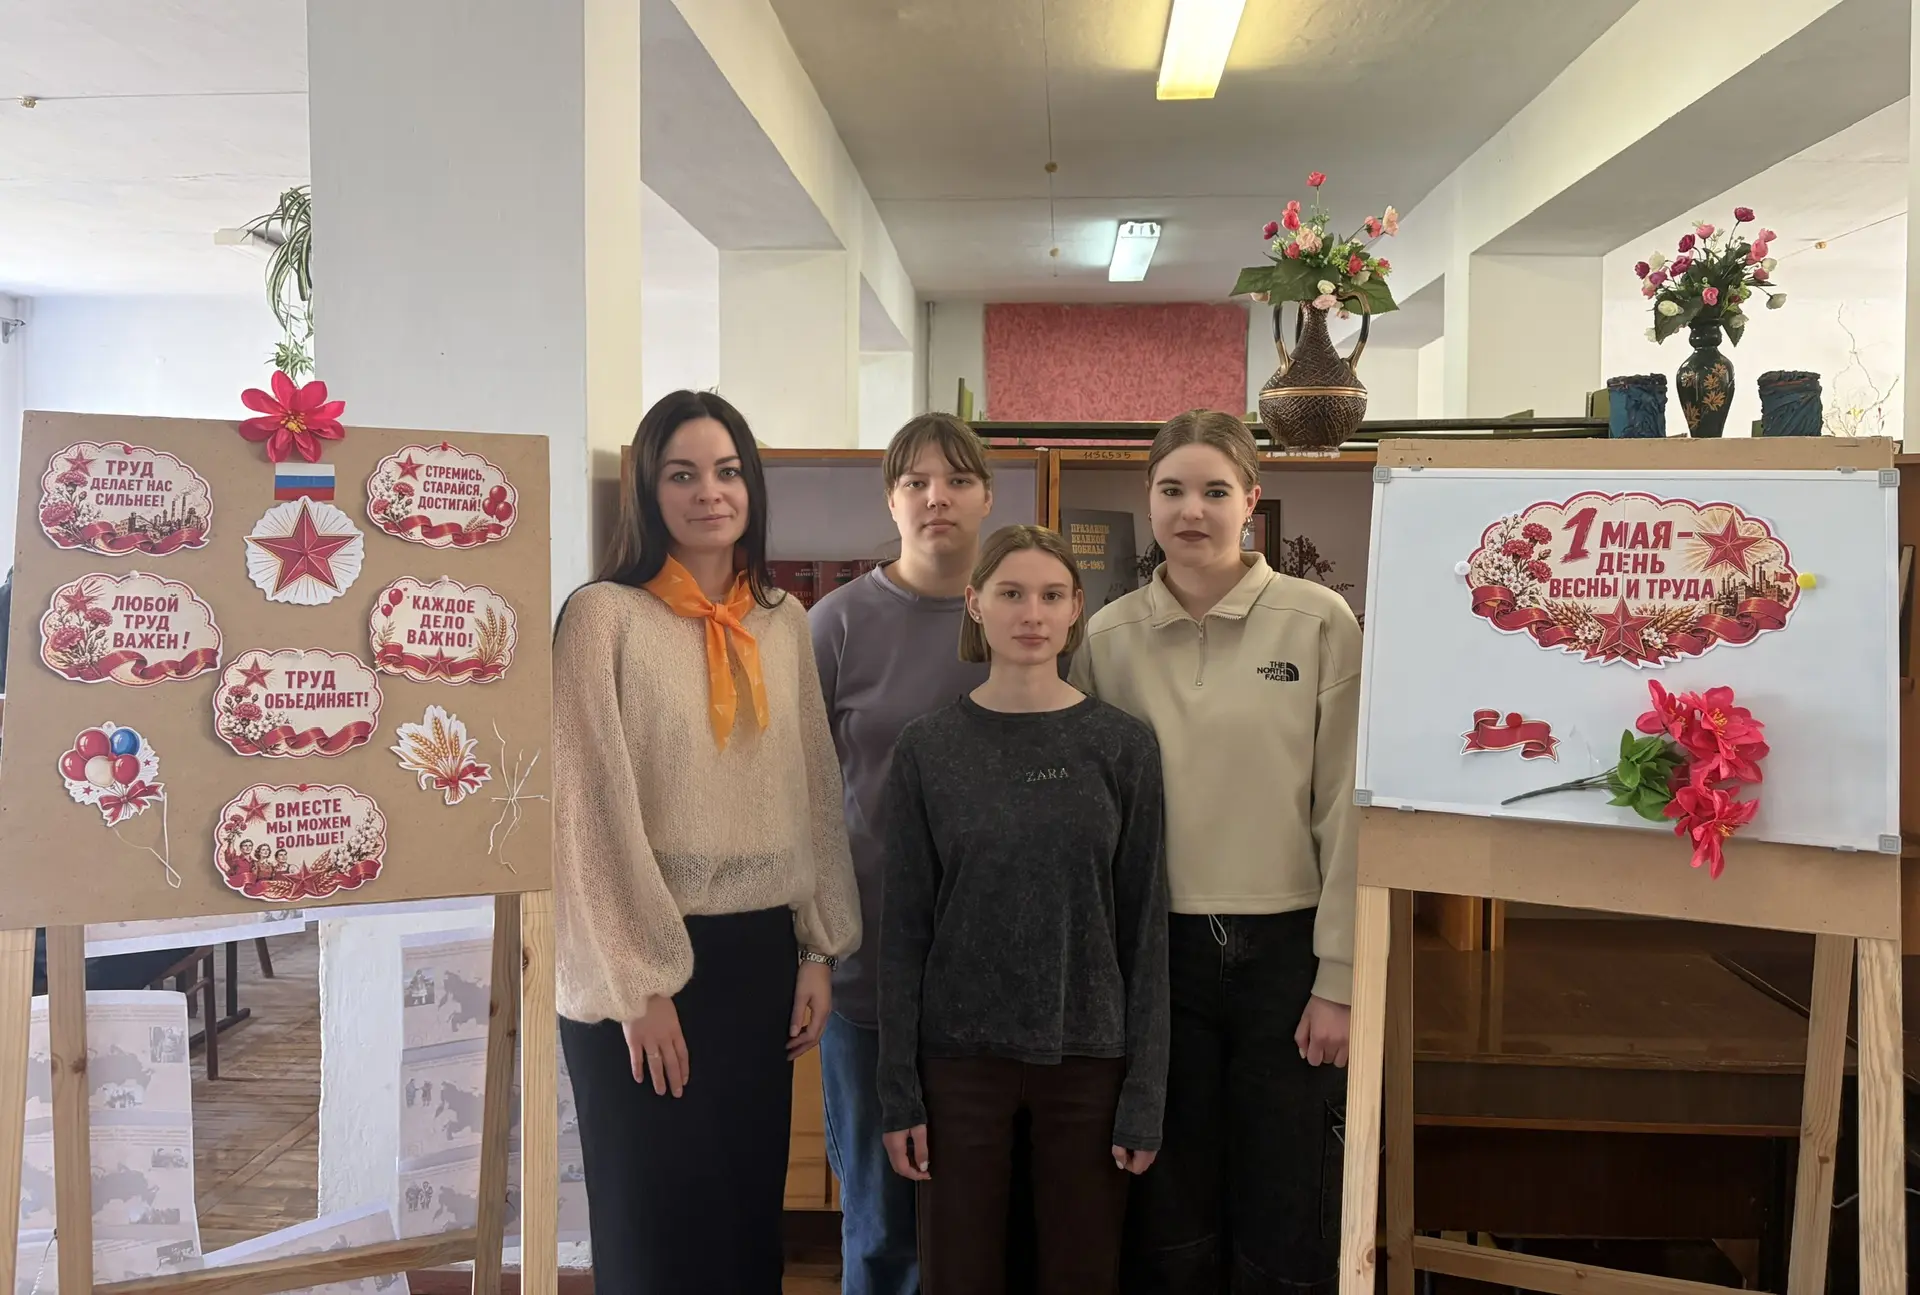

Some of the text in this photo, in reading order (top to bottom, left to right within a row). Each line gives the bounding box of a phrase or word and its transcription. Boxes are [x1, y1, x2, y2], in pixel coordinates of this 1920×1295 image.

[105, 460, 154, 479] ТРУД
[425, 465, 485, 483] СТРЕМИСЬ,
[90, 477, 173, 492] ДЕЛАЕТ НАС
[423, 480, 483, 498] СТАРАЙСЯ,
[95, 493, 165, 508] СИЛЬНЕЕ!
[417, 495, 481, 512] ДОСТИГАЙ!
[1559, 507, 1598, 564] 1
[1595, 551, 1666, 576] ДЕНЬ
[1549, 577, 1715, 602] ВЕСНЫ И ТРУДА
[111, 593, 179, 612] ЛЮБОЙ
[412, 595, 476, 614] КАЖДОЕ
[123, 614, 170, 632] ТРУД
[420, 613, 465, 630] ДЕЛО
[406, 629, 474, 648] ВАЖНО!
[1256, 666, 1286, 675] NORTH
[1269, 660, 1286, 669] THE
[284, 670, 336, 691] ТРУД
[1264, 673, 1286, 682] FACE
[264, 691, 369, 711] ОБЪЕДИНЯЕТ!
[1025, 767, 1069, 783] ZARA
[275, 798, 342, 819] ВМЕСТЕ
[266, 815, 351, 834] МЫ МОЖЕМ
[276, 830, 345, 849] БОЛЬШЕ!
